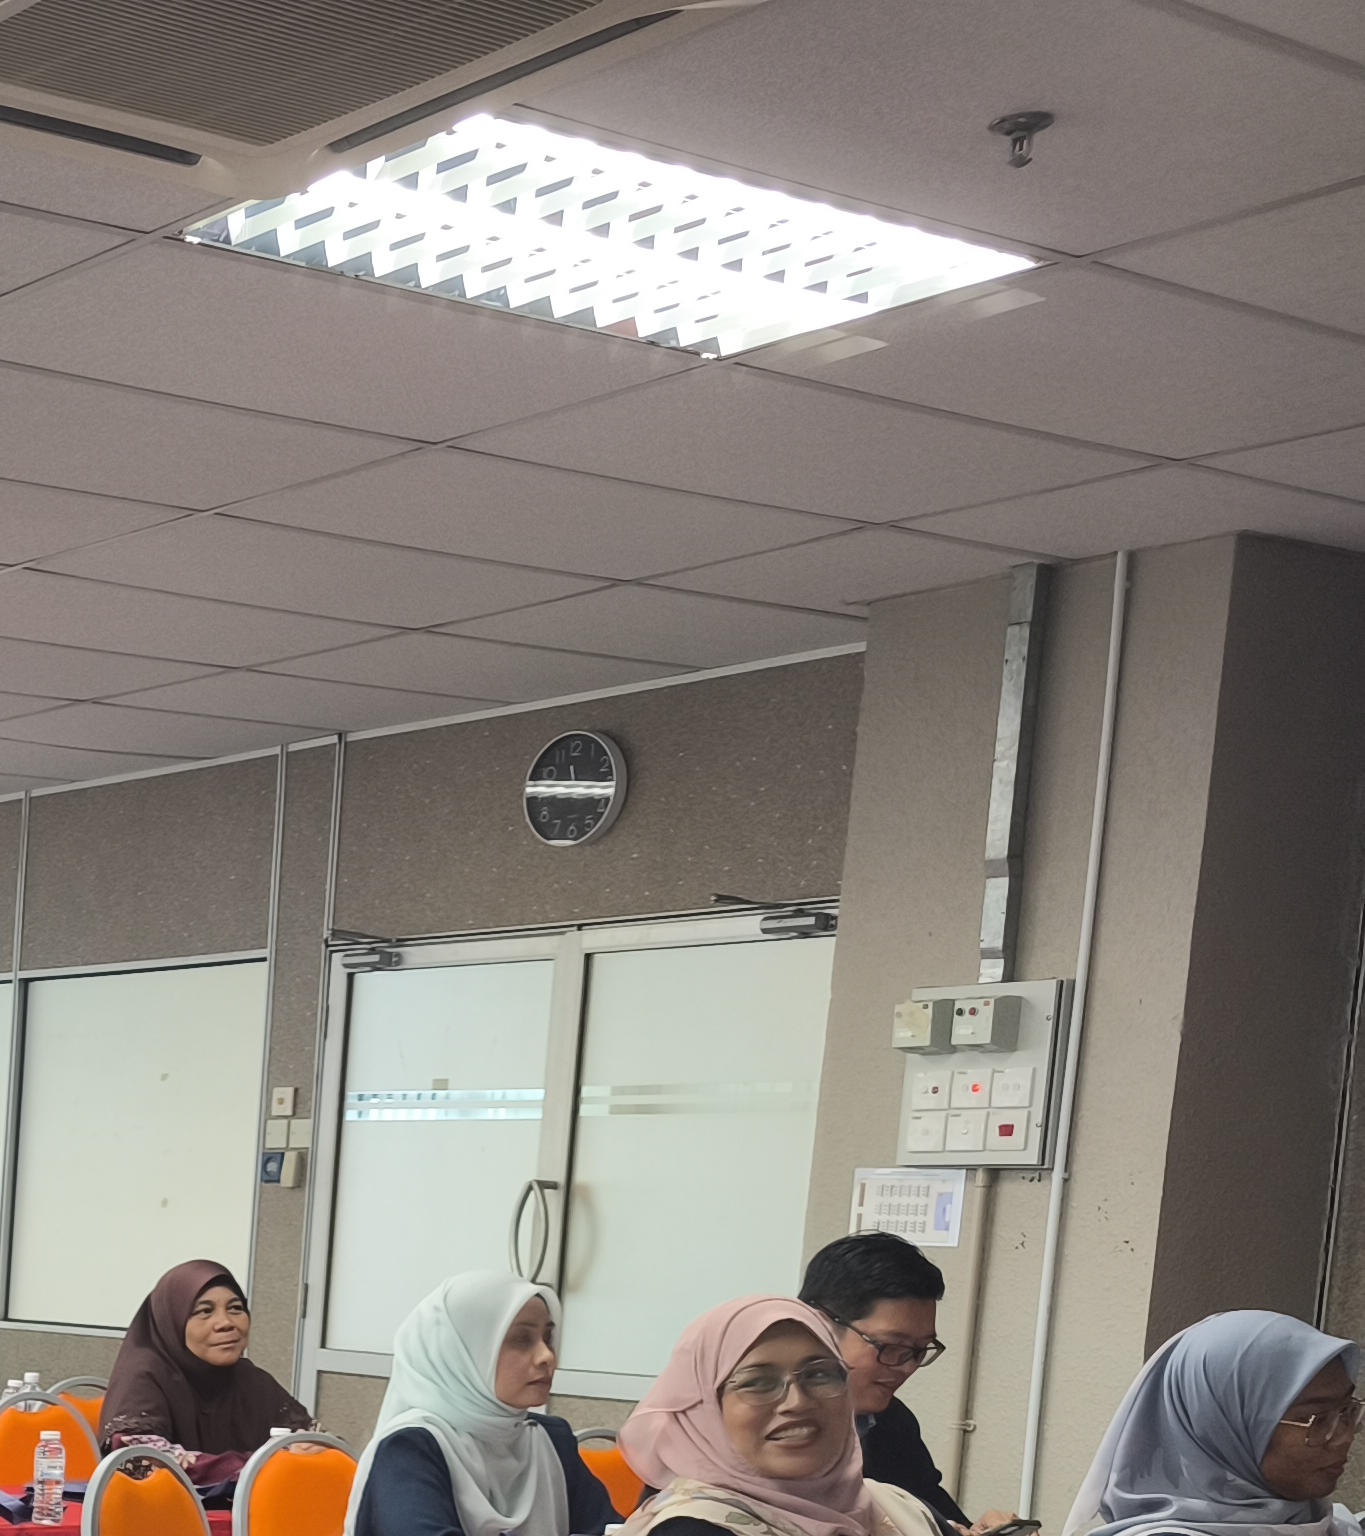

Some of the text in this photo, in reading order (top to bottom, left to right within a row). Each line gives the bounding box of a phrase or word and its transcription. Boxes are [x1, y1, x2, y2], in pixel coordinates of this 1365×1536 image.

[570, 741, 582, 756] 12
[555, 749, 565, 764] 11
[599, 756, 609, 771] 2
[597, 799, 605, 812] 4
[540, 806, 549, 822] 8
[551, 820, 561, 836] 7
[567, 823, 577, 838] 6
[584, 815, 594, 831] 5
